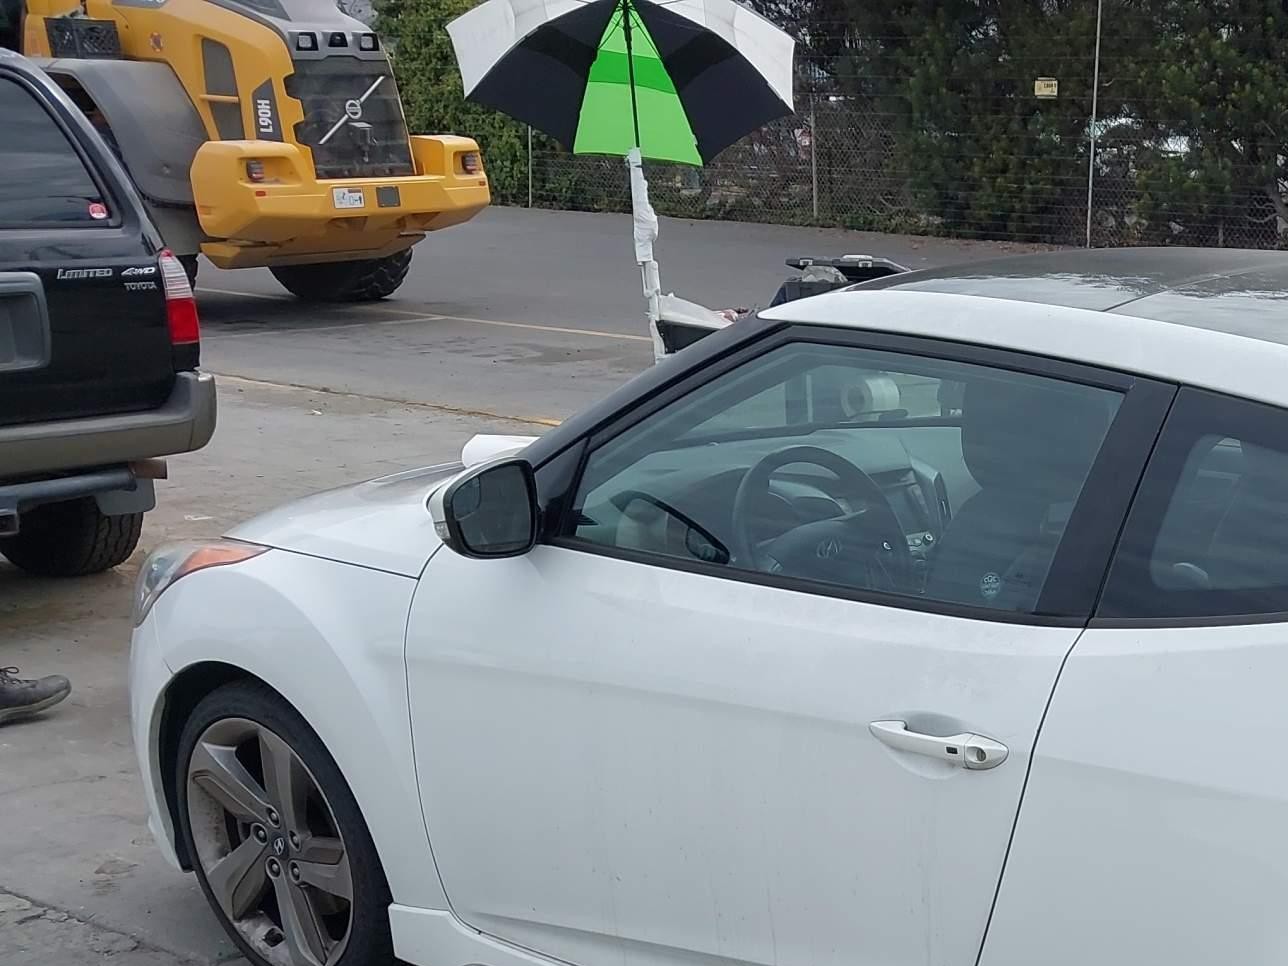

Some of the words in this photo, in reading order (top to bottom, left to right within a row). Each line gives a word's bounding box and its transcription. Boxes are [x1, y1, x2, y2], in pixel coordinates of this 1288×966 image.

[257, 99, 273, 133] L90H
[121, 266, 156, 276] 4WD
[123, 281, 157, 291] TOYOTA
